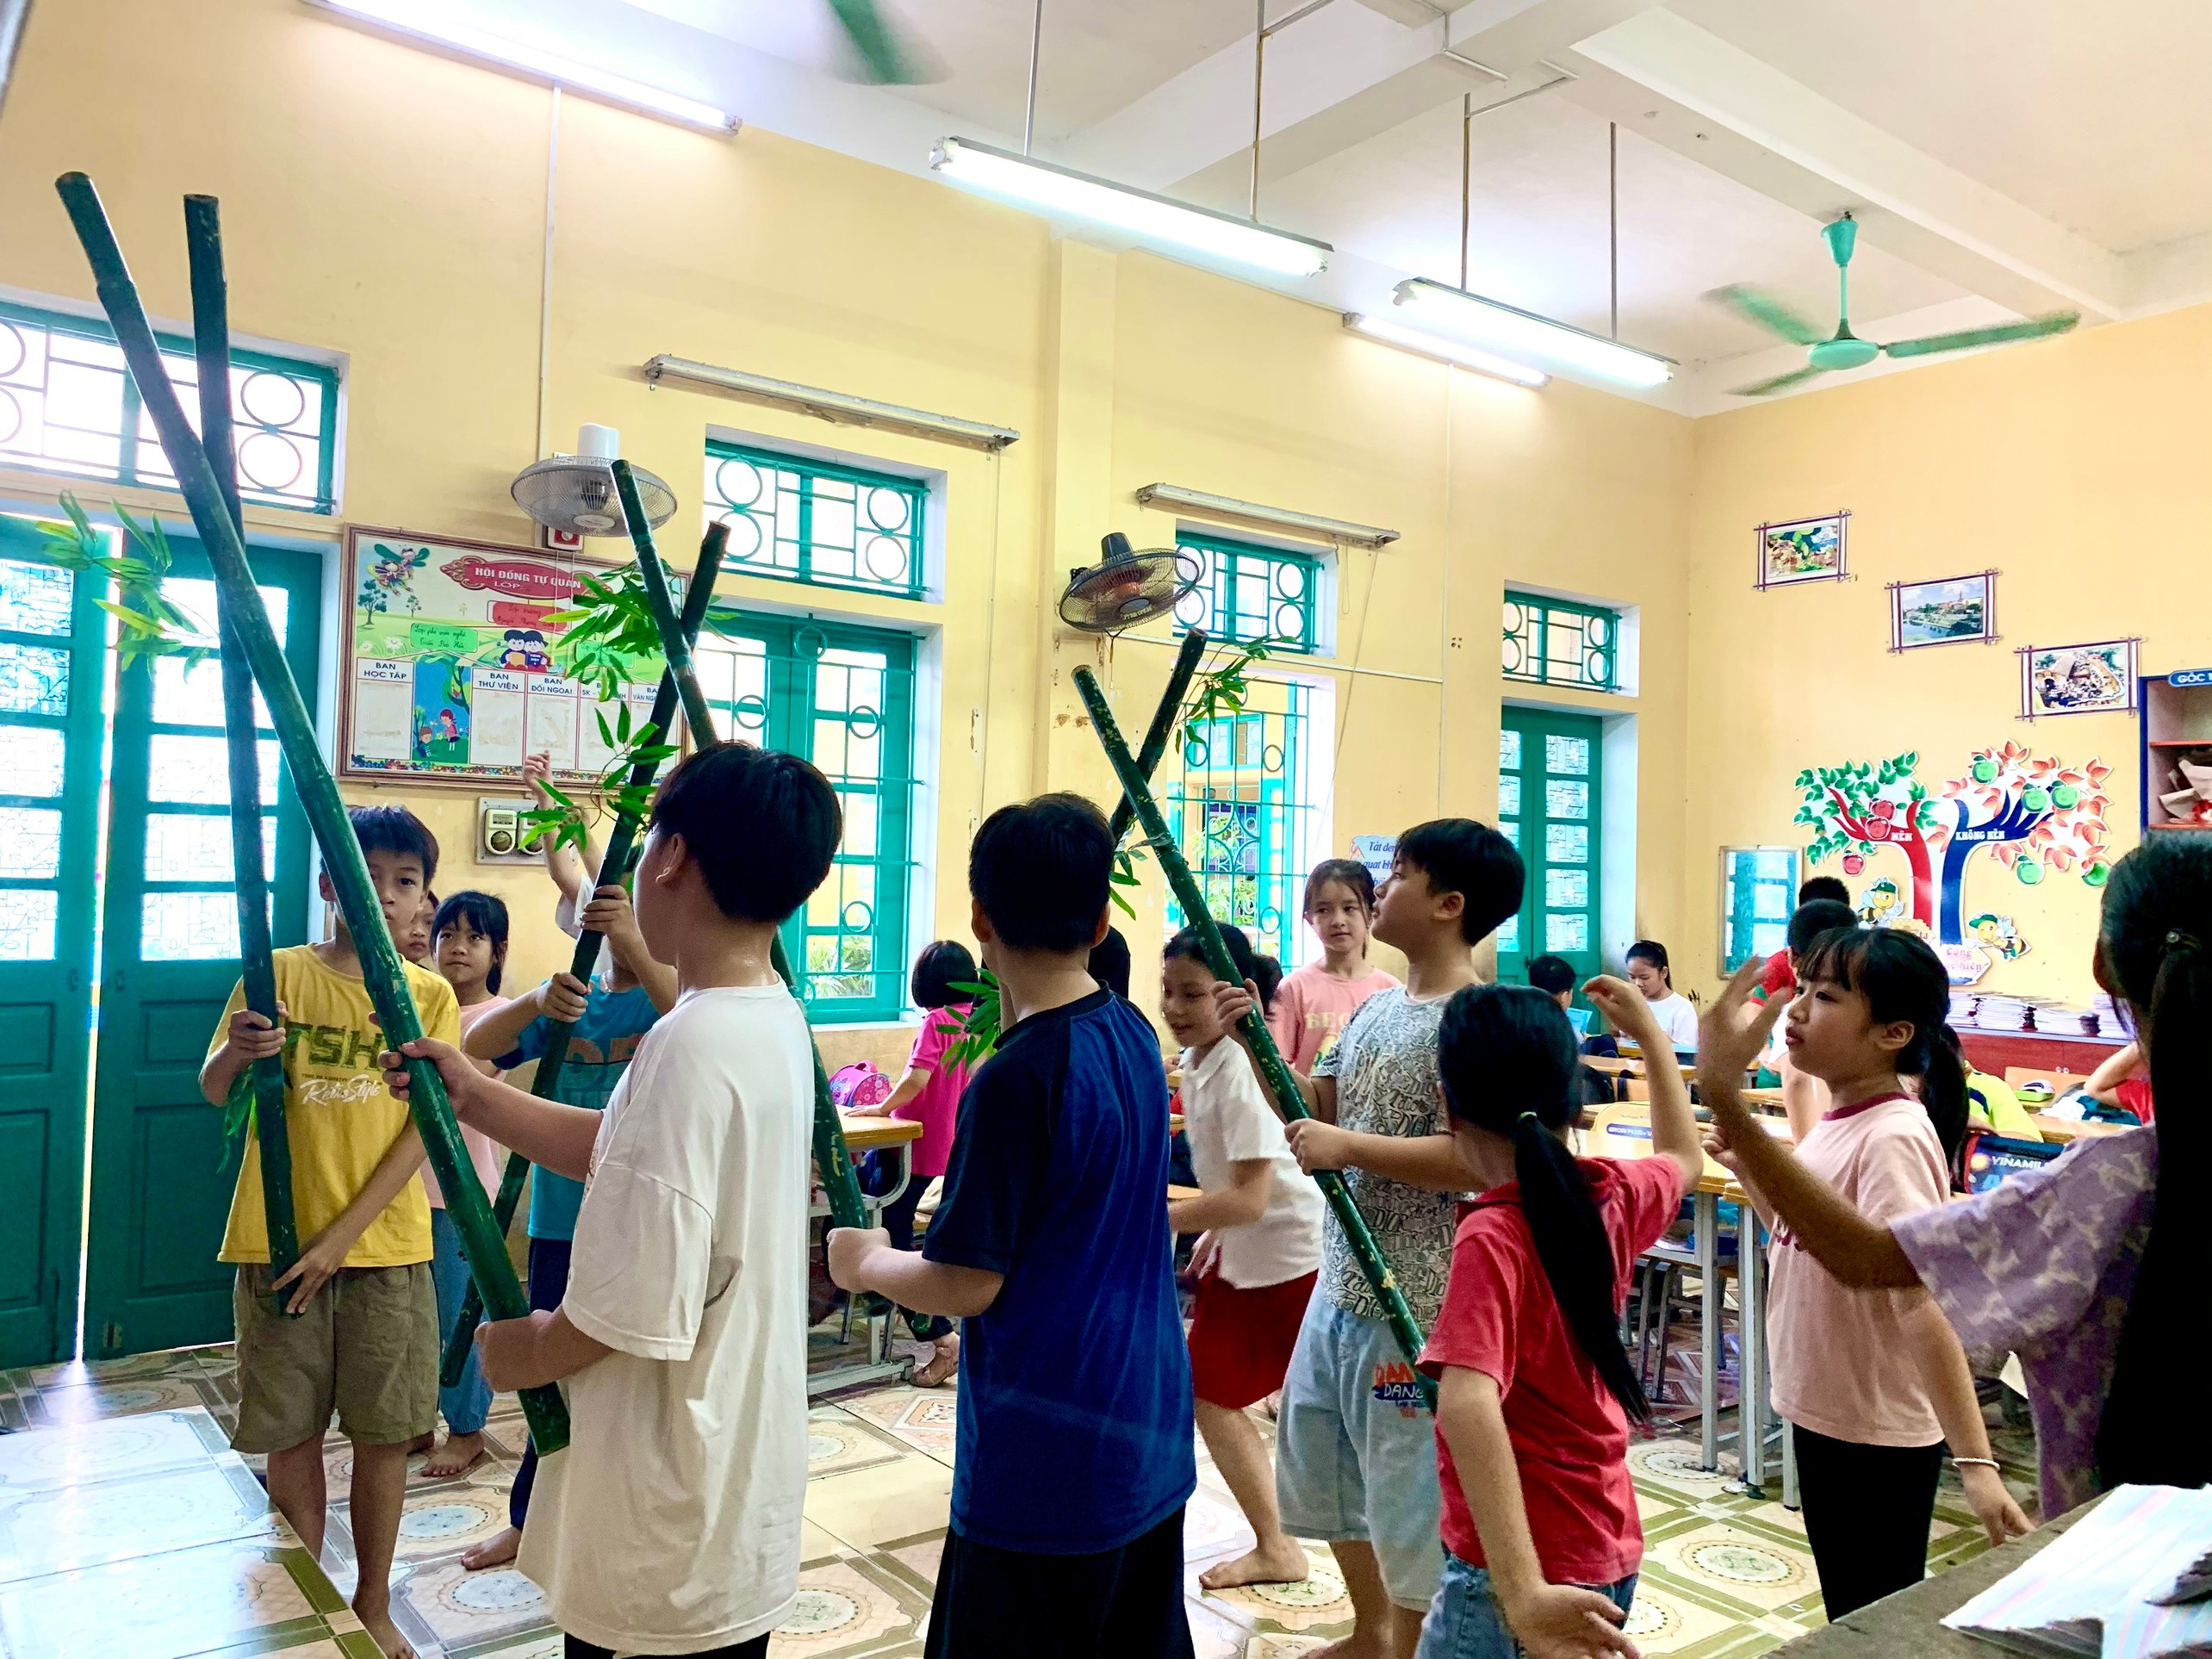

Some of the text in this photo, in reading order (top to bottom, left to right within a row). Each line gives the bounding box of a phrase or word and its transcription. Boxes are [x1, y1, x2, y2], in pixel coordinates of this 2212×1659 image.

[475, 567, 495, 579] HỘI
[376, 662, 396, 670] BAN
[363, 669, 387, 679] HỌC
[489, 672, 509, 680] BAN
[2178, 672, 2206, 683] GÓC
[544, 677, 562, 686] BAN
[1891, 830, 1912, 841] NÊN
[1955, 829, 2004, 840] KHÔNG NÊN
[283, 1021, 384, 1071] TSH
